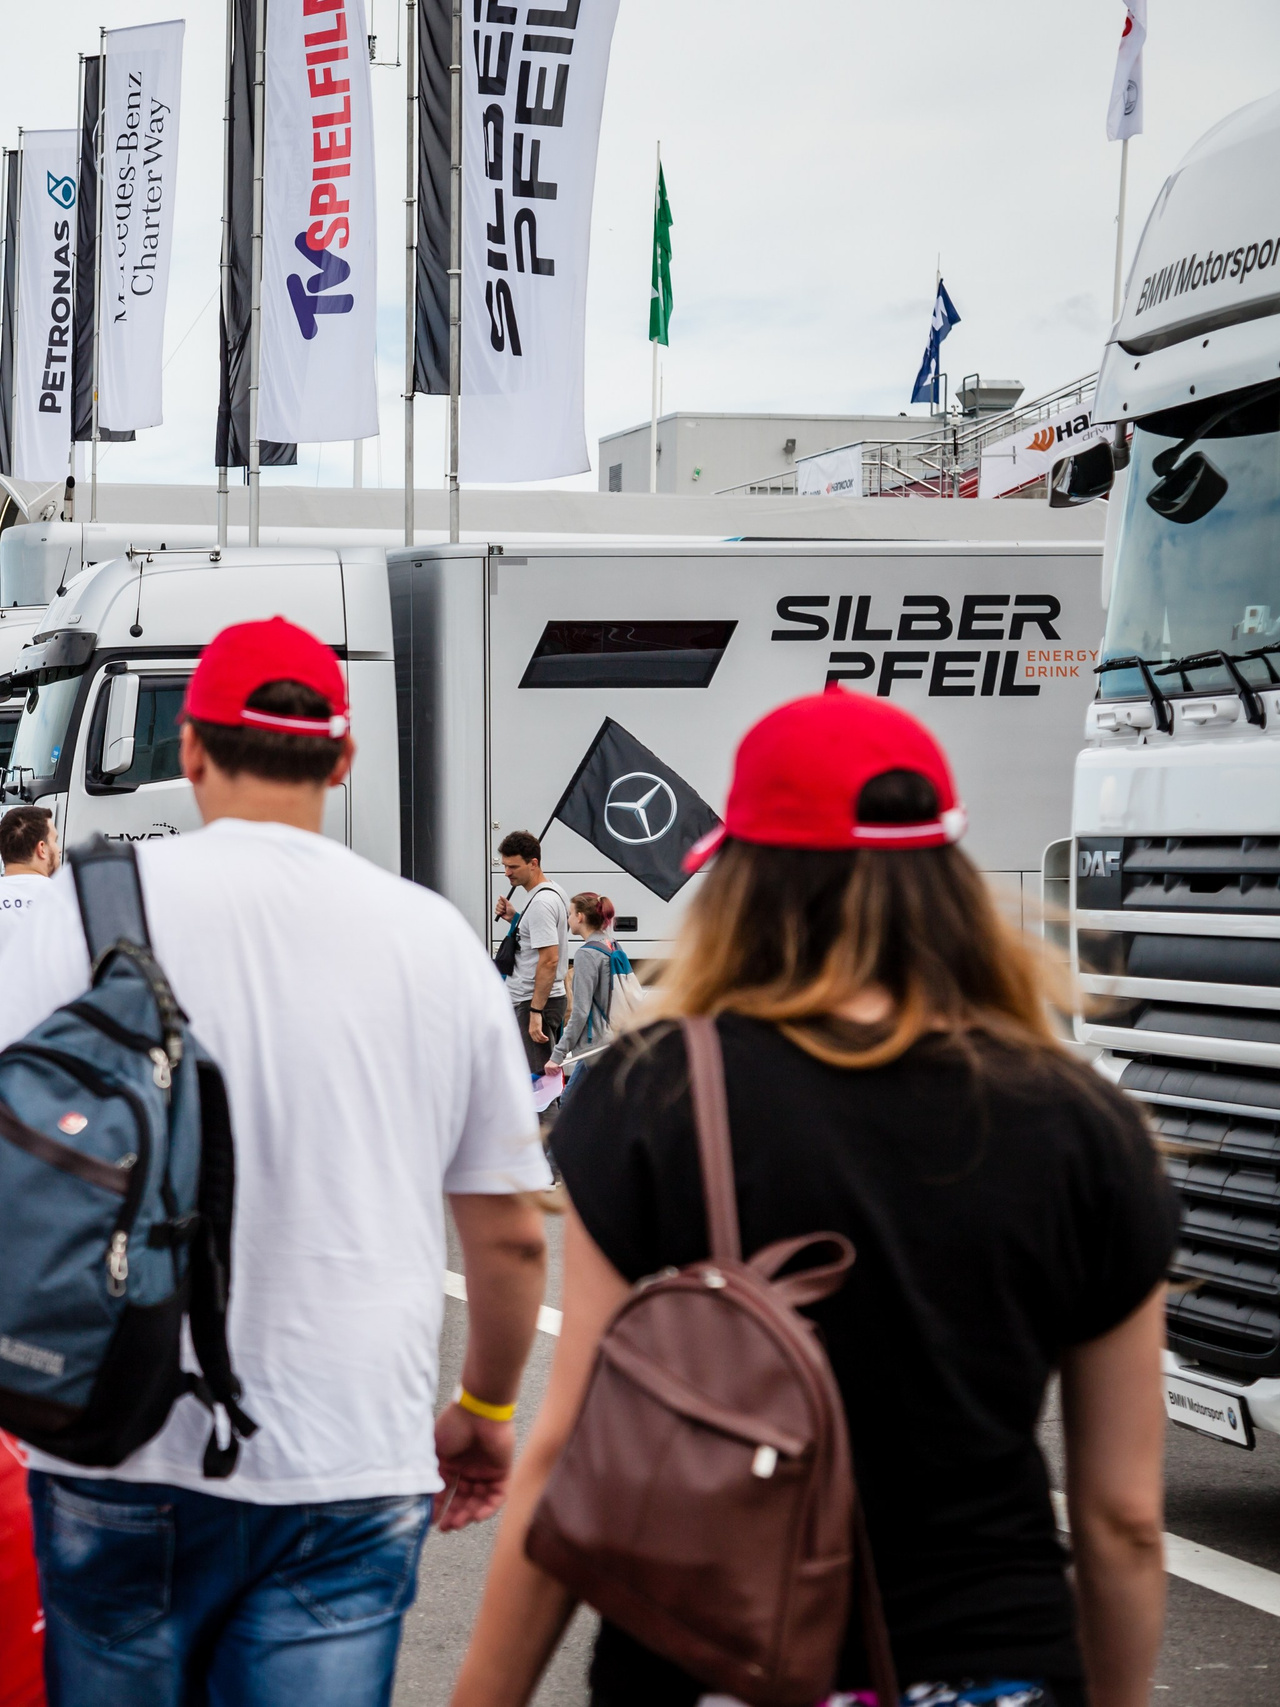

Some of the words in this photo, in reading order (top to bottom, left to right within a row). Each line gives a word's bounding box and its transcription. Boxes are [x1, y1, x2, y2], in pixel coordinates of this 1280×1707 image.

[286, 231, 354, 340] TV
[1135, 261, 1181, 316] BMW
[38, 219, 71, 413] PETRONAS
[771, 594, 1061, 641] SILBER
[824, 650, 1041, 697] PFEIL
[1027, 650, 1099, 662] ENERGY
[1025, 666, 1080, 678] DRINK
[1078, 850, 1120, 877] DAF
[1168, 1391, 1187, 1409] BMW
[1187, 1397, 1226, 1422] Motorsport
